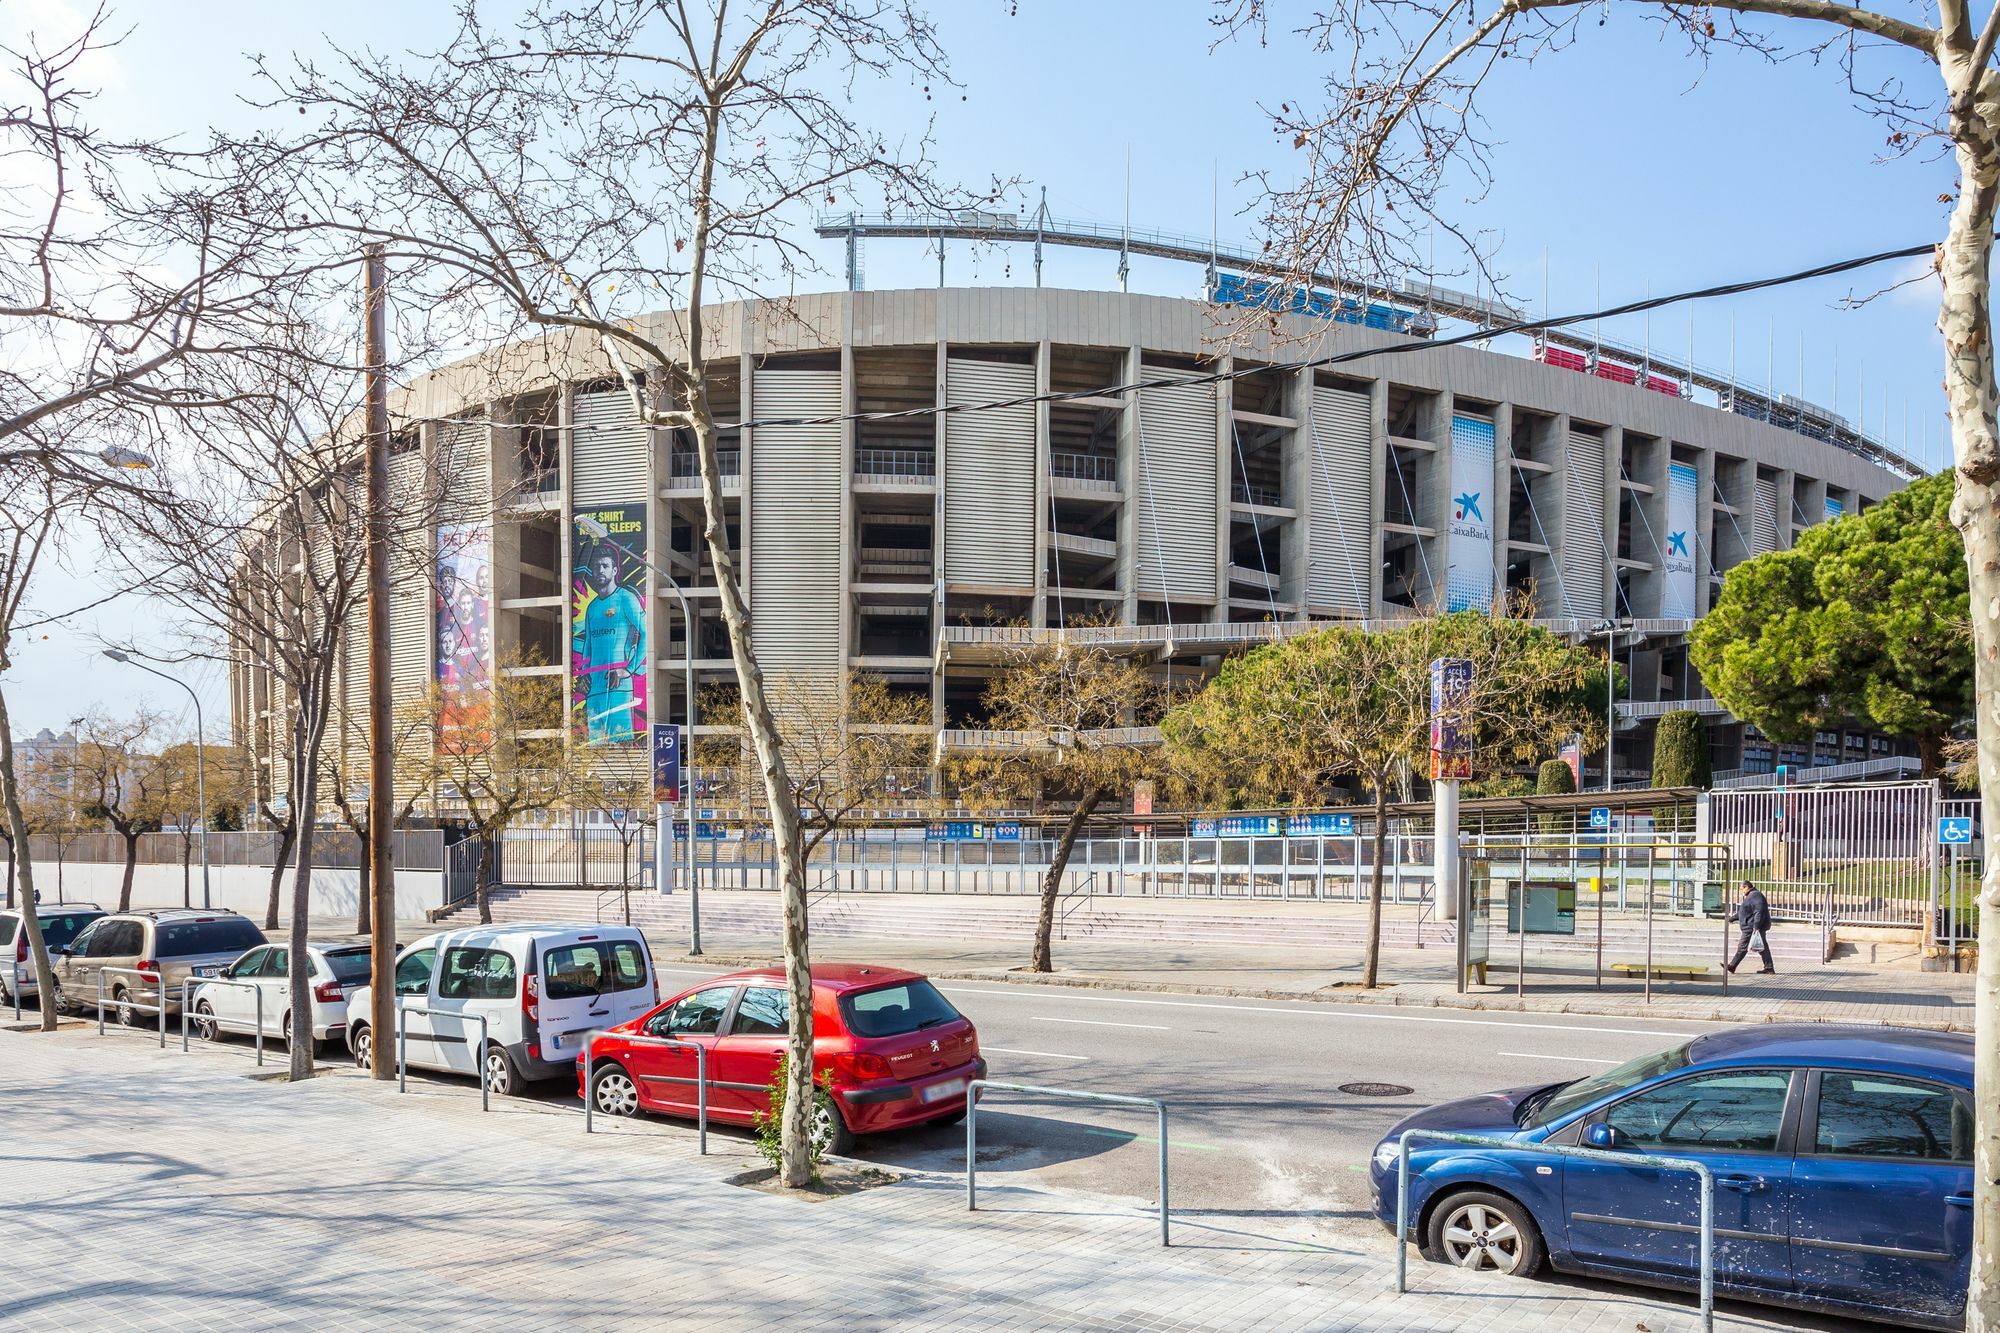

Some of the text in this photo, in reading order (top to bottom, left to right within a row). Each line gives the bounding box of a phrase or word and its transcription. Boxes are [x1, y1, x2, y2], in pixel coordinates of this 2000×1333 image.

[598, 510, 625, 523] SHIRT
[609, 520, 642, 533] SLEEPS
[1665, 561, 1693, 574] aixaBank
[658, 736, 674, 749] 19
[891, 1053, 913, 1062] PEUGEOT
